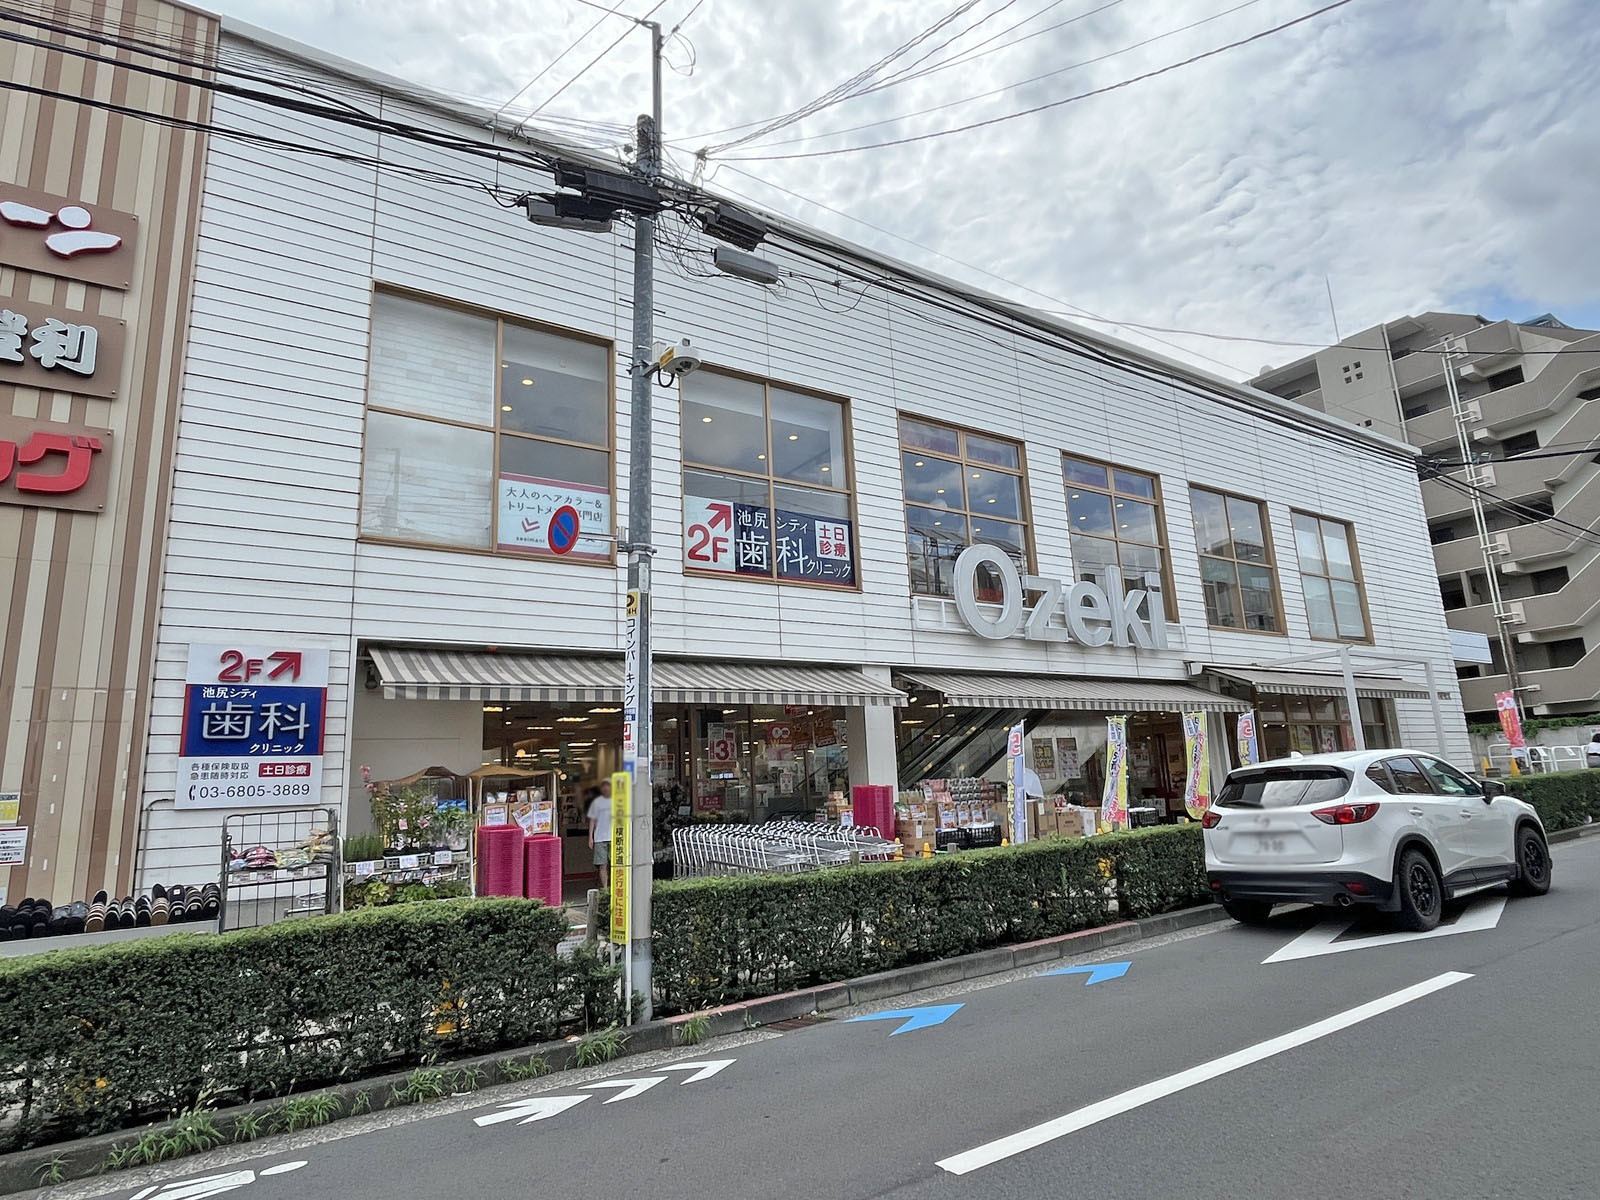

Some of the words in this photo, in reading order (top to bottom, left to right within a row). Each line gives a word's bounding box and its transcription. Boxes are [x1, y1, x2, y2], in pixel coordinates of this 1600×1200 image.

[0, 431, 102, 491] グ
[506, 486, 603, 509] 大人のヘアカラー&
[736, 508, 809, 535] 池尻シティ
[818, 524, 845, 542] 土日
[687, 523, 730, 563] 2F
[735, 530, 810, 575] 歯科
[818, 540, 848, 558] 診療
[806, 558, 851, 579] クリニック
[954, 543, 1169, 650] Ozeki
[218, 650, 264, 682] 2F
[625, 618, 636, 707] コインパーキング
[202, 687, 257, 699] 池尻シティ
[201, 701, 310, 740] 歯科
[249, 743, 304, 754] クリニック
[190, 762, 250, 772] 各種保険取扱
[261, 764, 308, 776] 土日診療
[199, 783, 311, 798] 03-6805-3889
